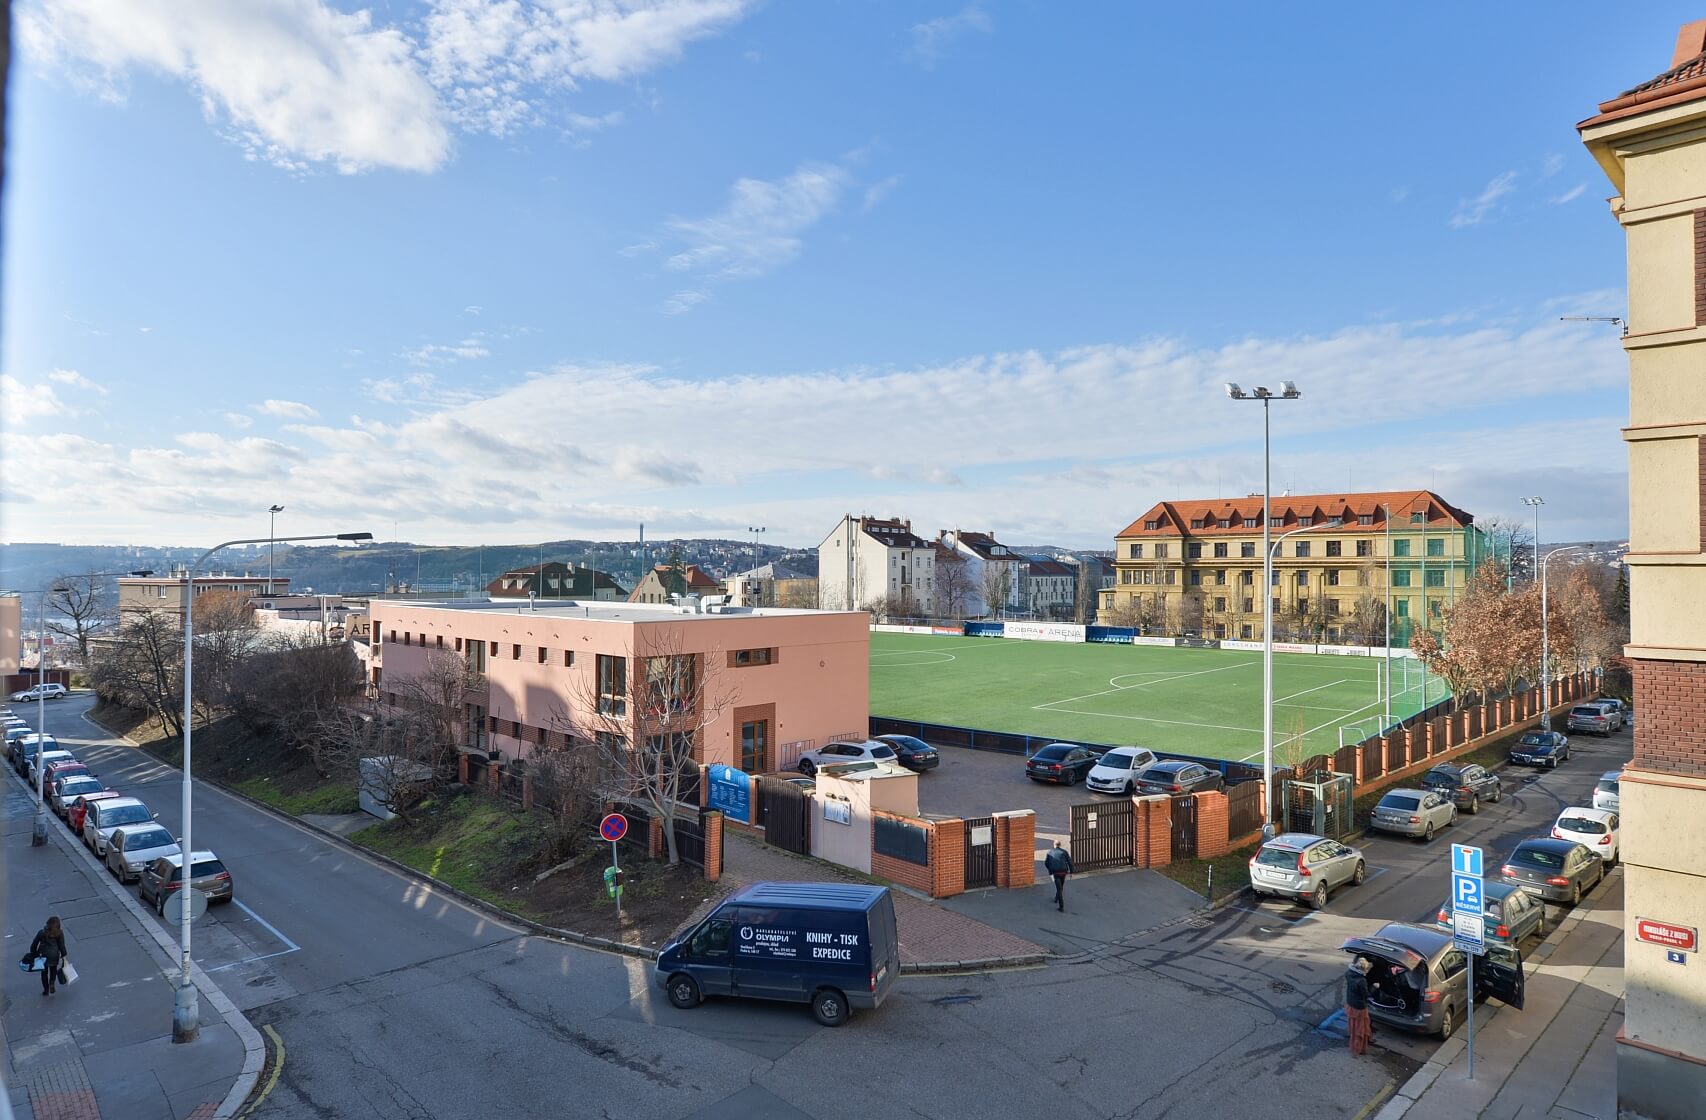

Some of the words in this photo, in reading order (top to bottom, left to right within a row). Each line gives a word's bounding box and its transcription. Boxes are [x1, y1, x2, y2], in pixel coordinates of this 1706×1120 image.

[1048, 628, 1081, 636] ARENA
[1458, 879, 1477, 901] P
[756, 933, 789, 942] OLYMPIA
[806, 932, 832, 944] KNIHY
[840, 934, 858, 945] TISK
[813, 947, 851, 960] EXPEDICE
[1672, 953, 1679, 961] 3
